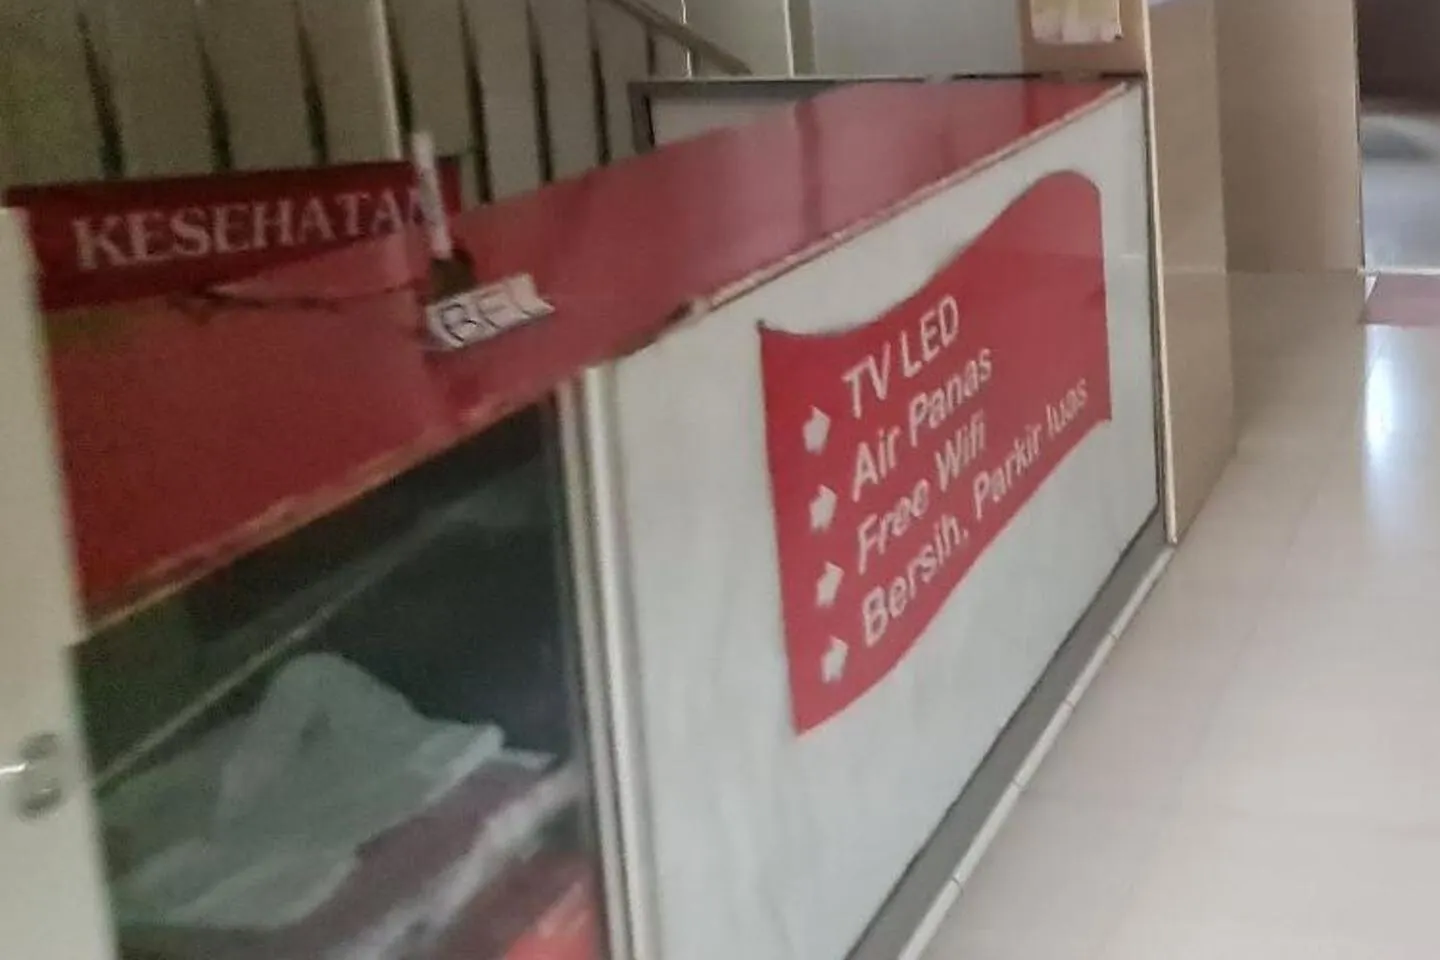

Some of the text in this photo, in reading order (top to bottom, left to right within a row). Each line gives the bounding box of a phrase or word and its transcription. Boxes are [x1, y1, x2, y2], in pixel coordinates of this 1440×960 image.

[841, 295, 959, 420] TV LED
[852, 348, 992, 503] Air Panas
[858, 409, 985, 575] Free Wifi
[973, 423, 1043, 521] Parkir
[1045, 377, 1088, 438] luas
